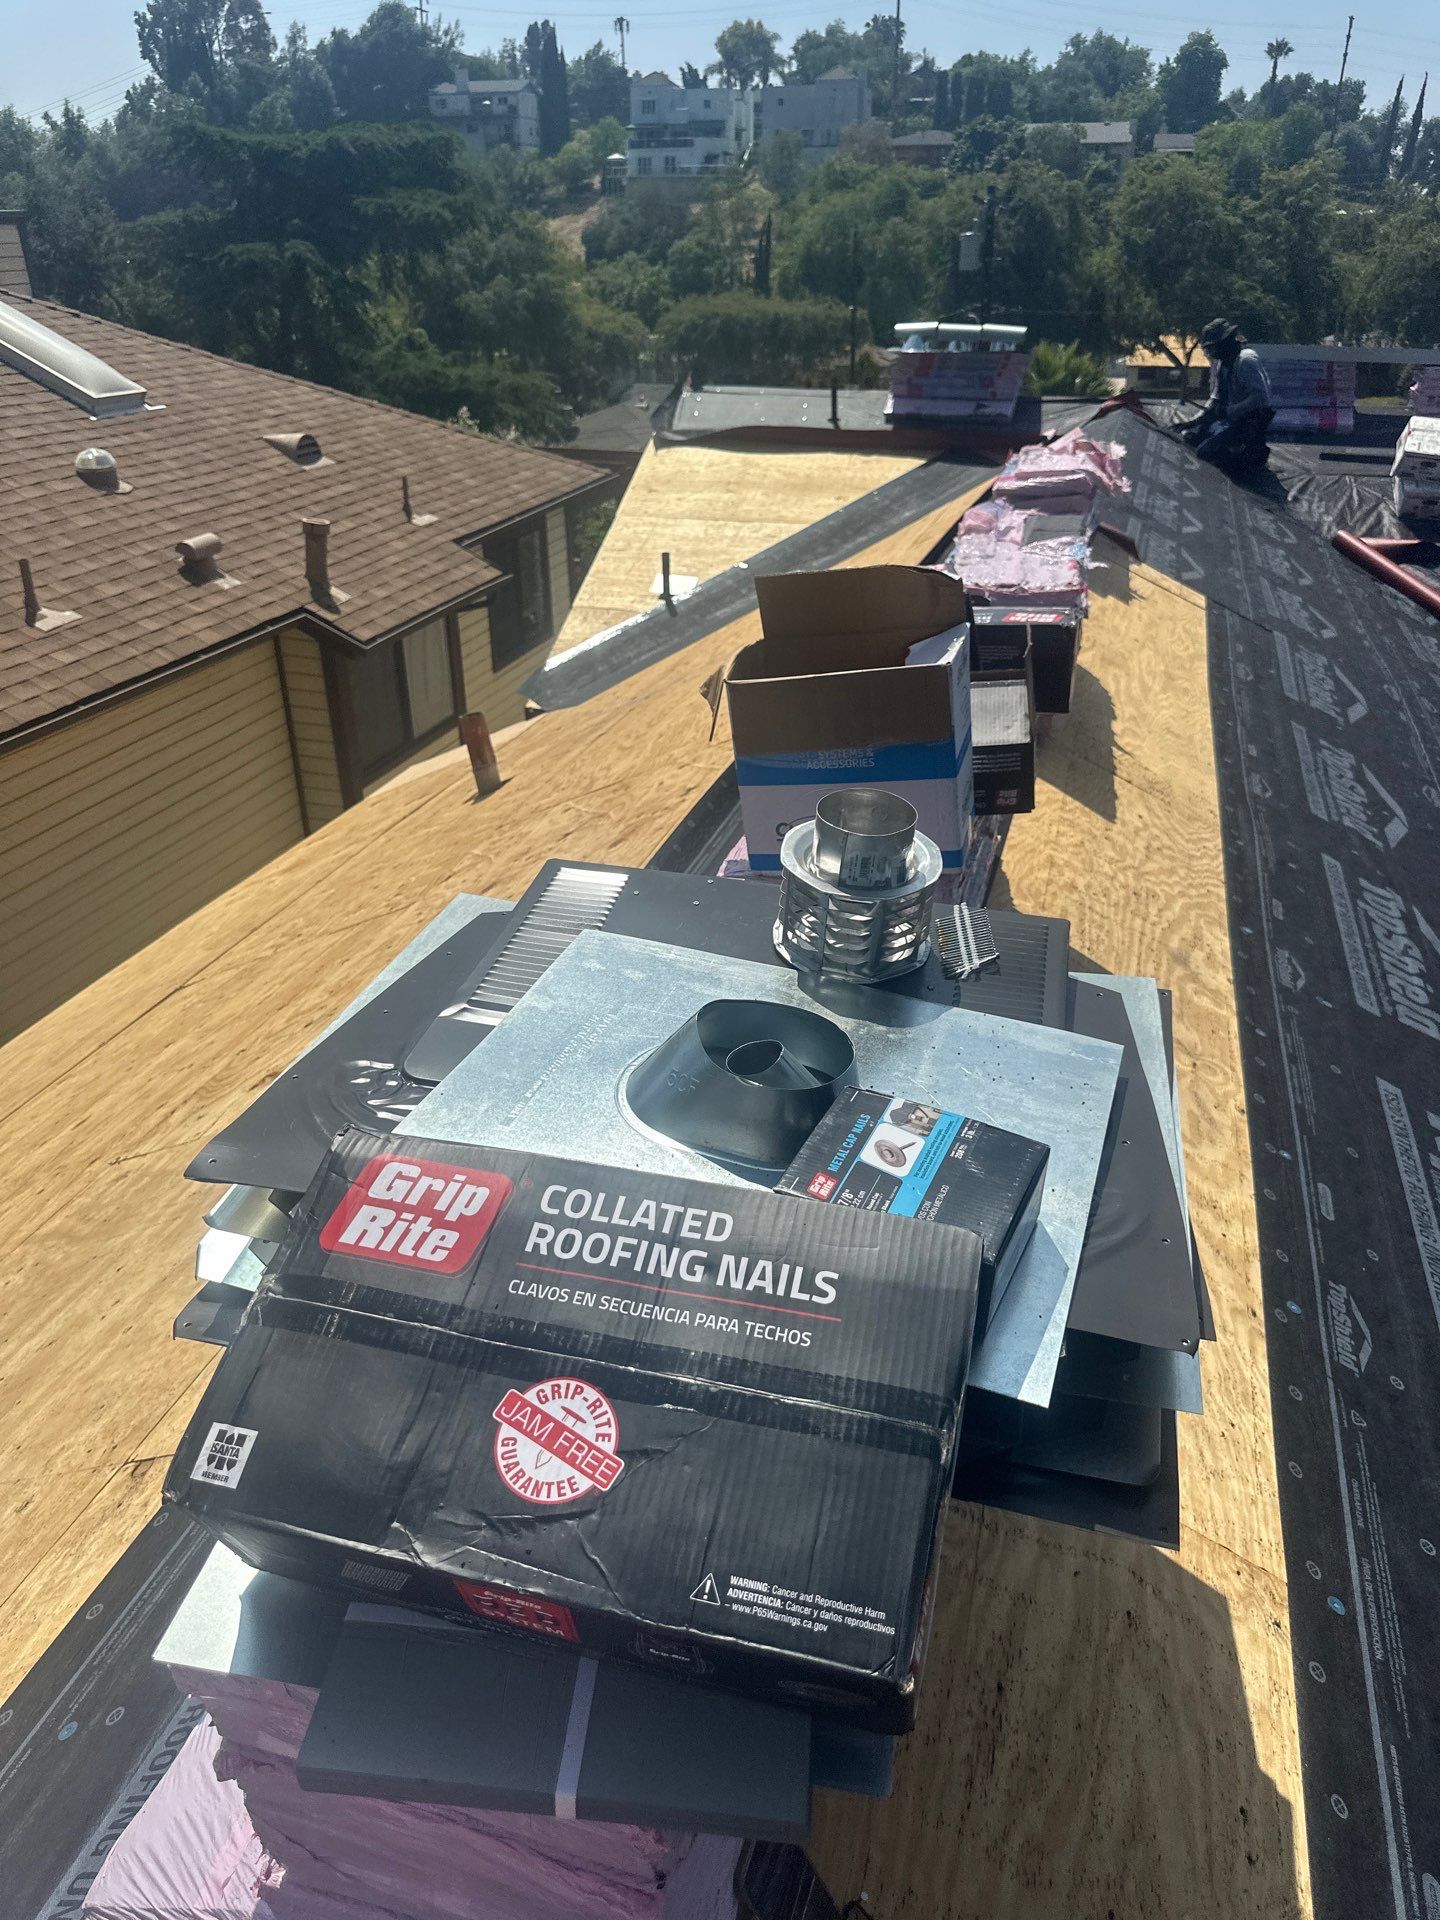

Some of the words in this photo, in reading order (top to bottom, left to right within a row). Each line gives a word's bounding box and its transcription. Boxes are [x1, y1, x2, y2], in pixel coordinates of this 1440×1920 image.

[828, 1145, 848, 1172] METAL
[842, 1131, 858, 1150] CAP
[852, 1113, 870, 1134] NAILS
[367, 1162, 490, 1222] Grip
[540, 1182, 735, 1243] COLLATED
[338, 1204, 459, 1263] Rite
[524, 1221, 709, 1284] ROOFING
[716, 1254, 840, 1305] NAILS
[507, 1278, 570, 1304] CLAVOS
[572, 1289, 595, 1307] EN
[597, 1293, 692, 1325] SECUENCIA
[695, 1311, 740, 1333] PARA
[743, 1320, 812, 1347] TECHOS
[1328, 1281, 1358, 1376] TopShield
[500, 1400, 555, 1442] JAM
[553, 1431, 618, 1484] FREE
[536, 1383, 612, 1443] GRIP-RITE
[201, 1470, 230, 1483] MEMBER
[501, 1437, 580, 1498] GUARANTEE
[727, 1588, 784, 1608] ADVERTENCIA:
[785, 1600, 811, 1615] Cáncer
[820, 1609, 843, 1623] daños
[844, 1614, 896, 1635] reproductivos
[729, 1575, 771, 1592] WARNING:
[772, 1585, 798, 1599] Cancer
[799, 1592, 813, 1603] and
[815, 1595, 863, 1615] Reproductive
[864, 1606, 886, 1620] Harm
[731, 1602, 829, 1632] www.P65Warnings.ca.gov
